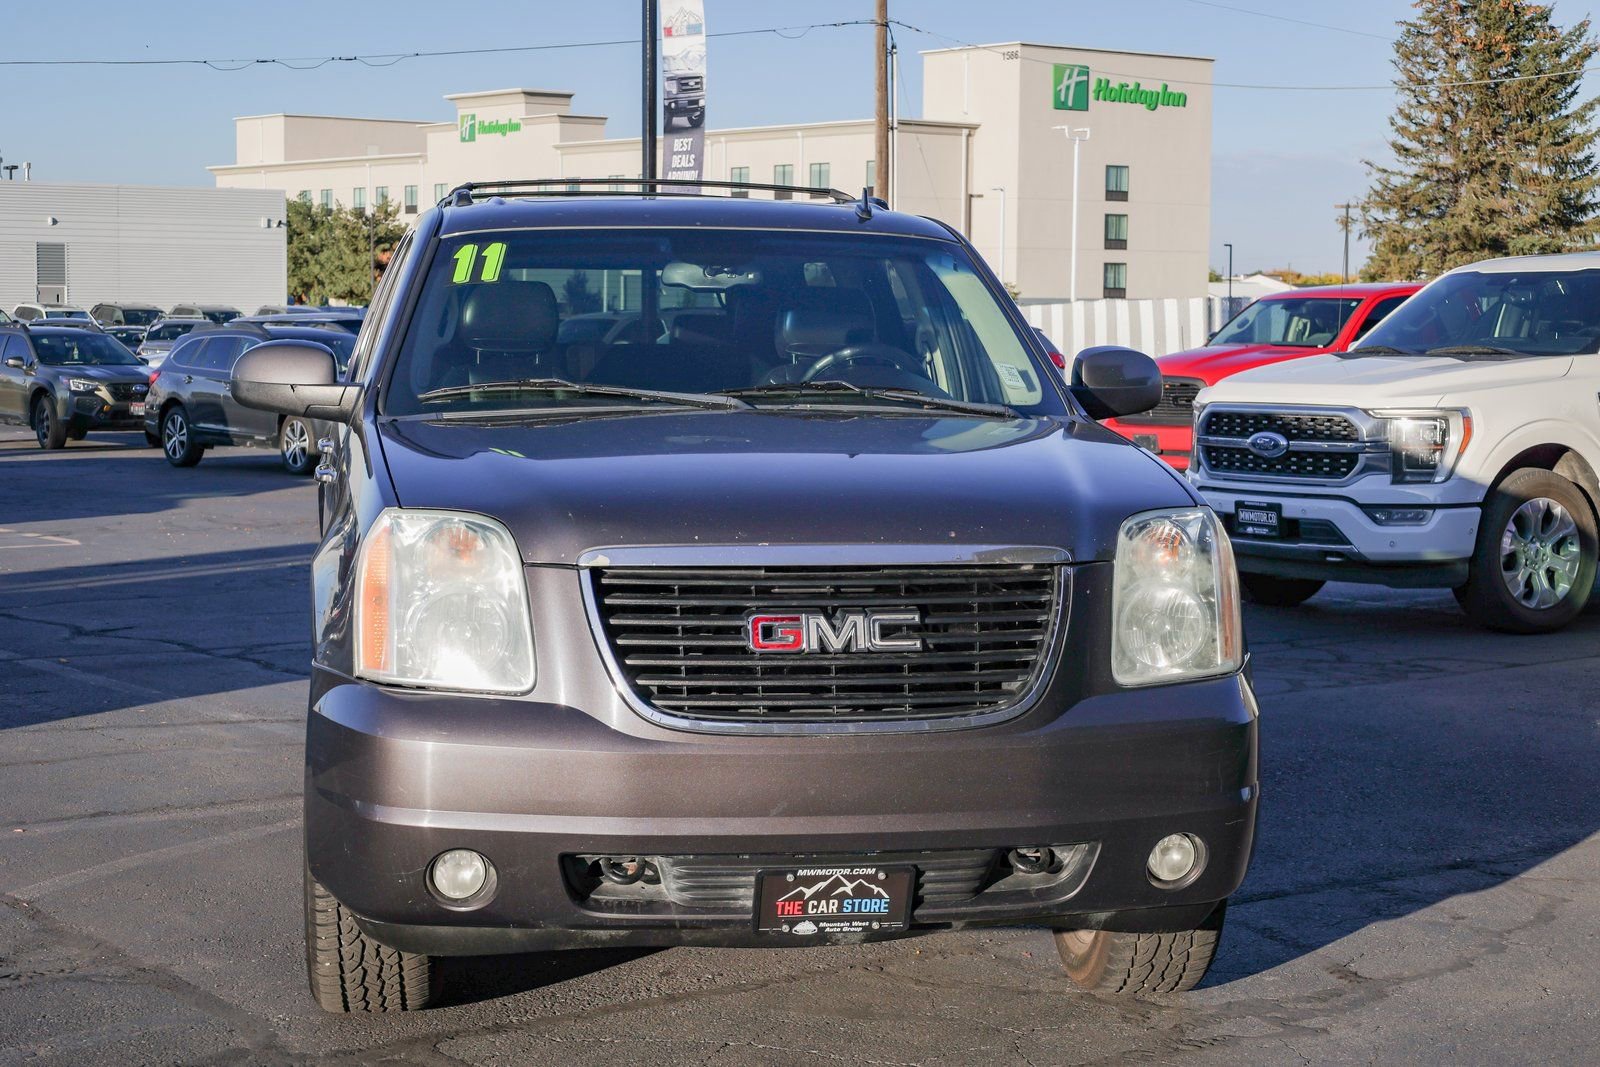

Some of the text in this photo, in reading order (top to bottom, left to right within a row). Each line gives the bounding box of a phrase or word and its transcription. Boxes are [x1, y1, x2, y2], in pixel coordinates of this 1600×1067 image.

[1093, 77, 1187, 111] Holiday Inn
[478, 118, 521, 137] Holiday Inn
[673, 138, 693, 152] BEST
[671, 154, 695, 168] DEALS
[452, 242, 507, 284] 11
[747, 611, 923, 653] GMC
[797, 868, 876, 876] MWMOTOR.COM
[776, 898, 890, 915] THE CAR STORE
